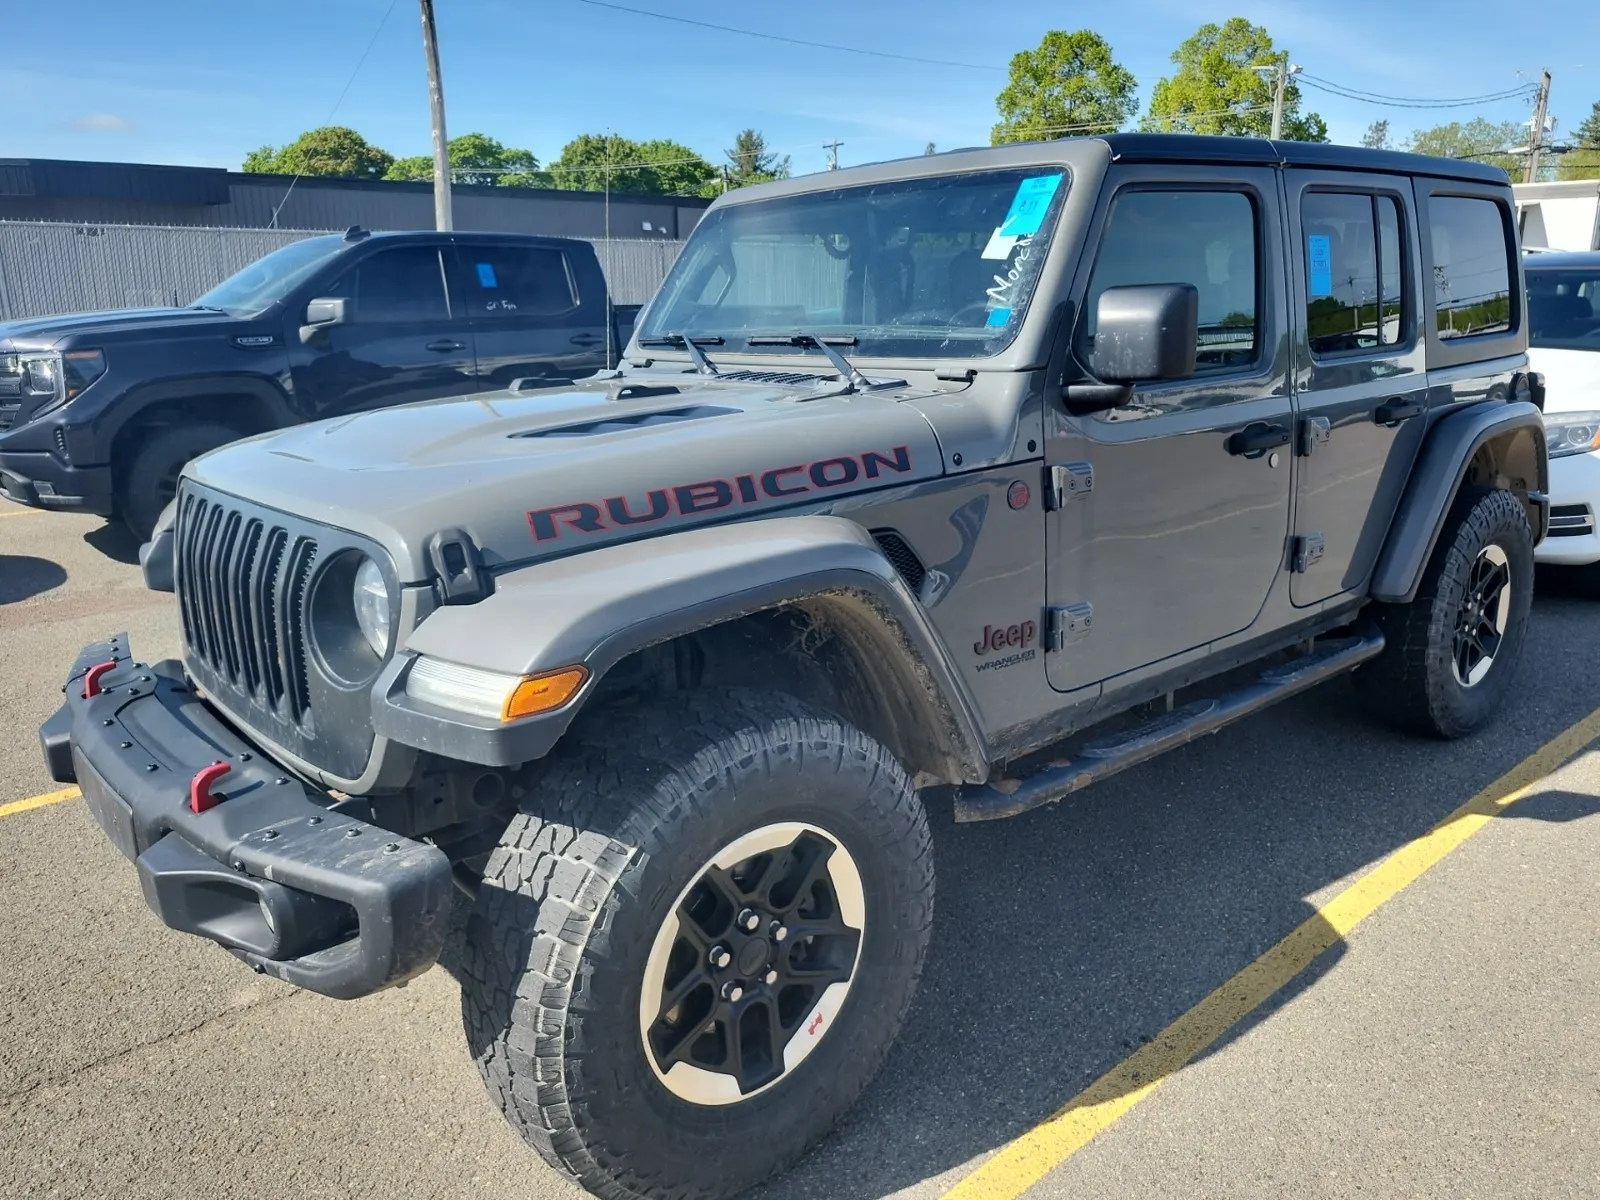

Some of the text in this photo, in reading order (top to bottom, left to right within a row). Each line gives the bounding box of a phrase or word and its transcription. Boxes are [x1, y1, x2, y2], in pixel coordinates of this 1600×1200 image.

[526, 445, 911, 542] RUBICON
[974, 620, 1036, 655] Jeep
[975, 649, 1036, 672] WRANGLER
